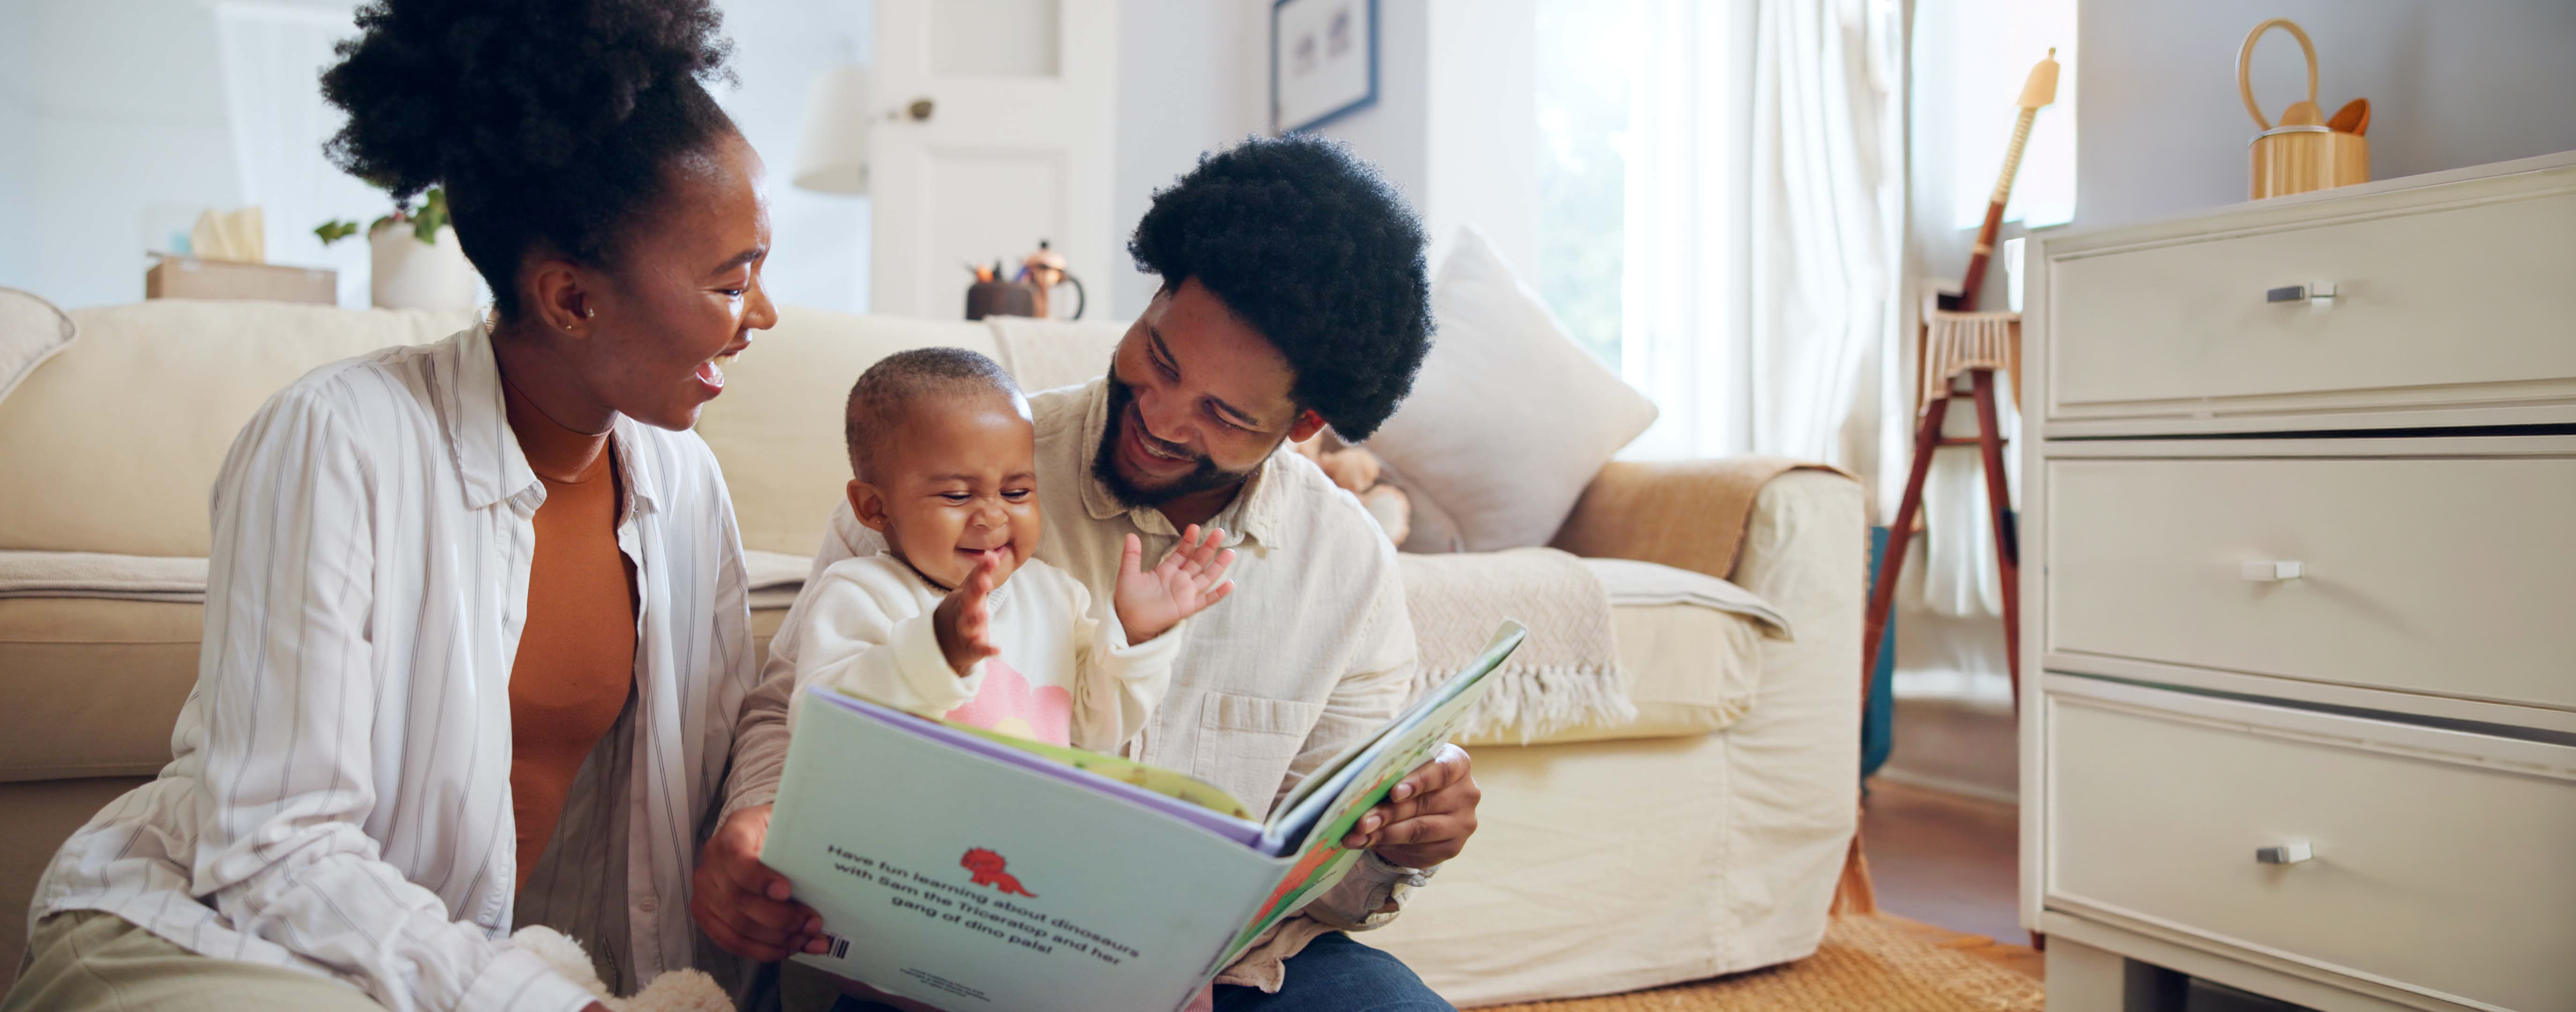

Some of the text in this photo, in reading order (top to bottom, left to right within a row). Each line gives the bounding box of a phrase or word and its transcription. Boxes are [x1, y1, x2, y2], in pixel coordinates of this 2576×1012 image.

[828, 844, 1140, 958] Have fun learning about dinosaurs
[835, 863, 1122, 966] with Sam the Triceratop and her
[892, 897, 1053, 954] gang of dino pals!
